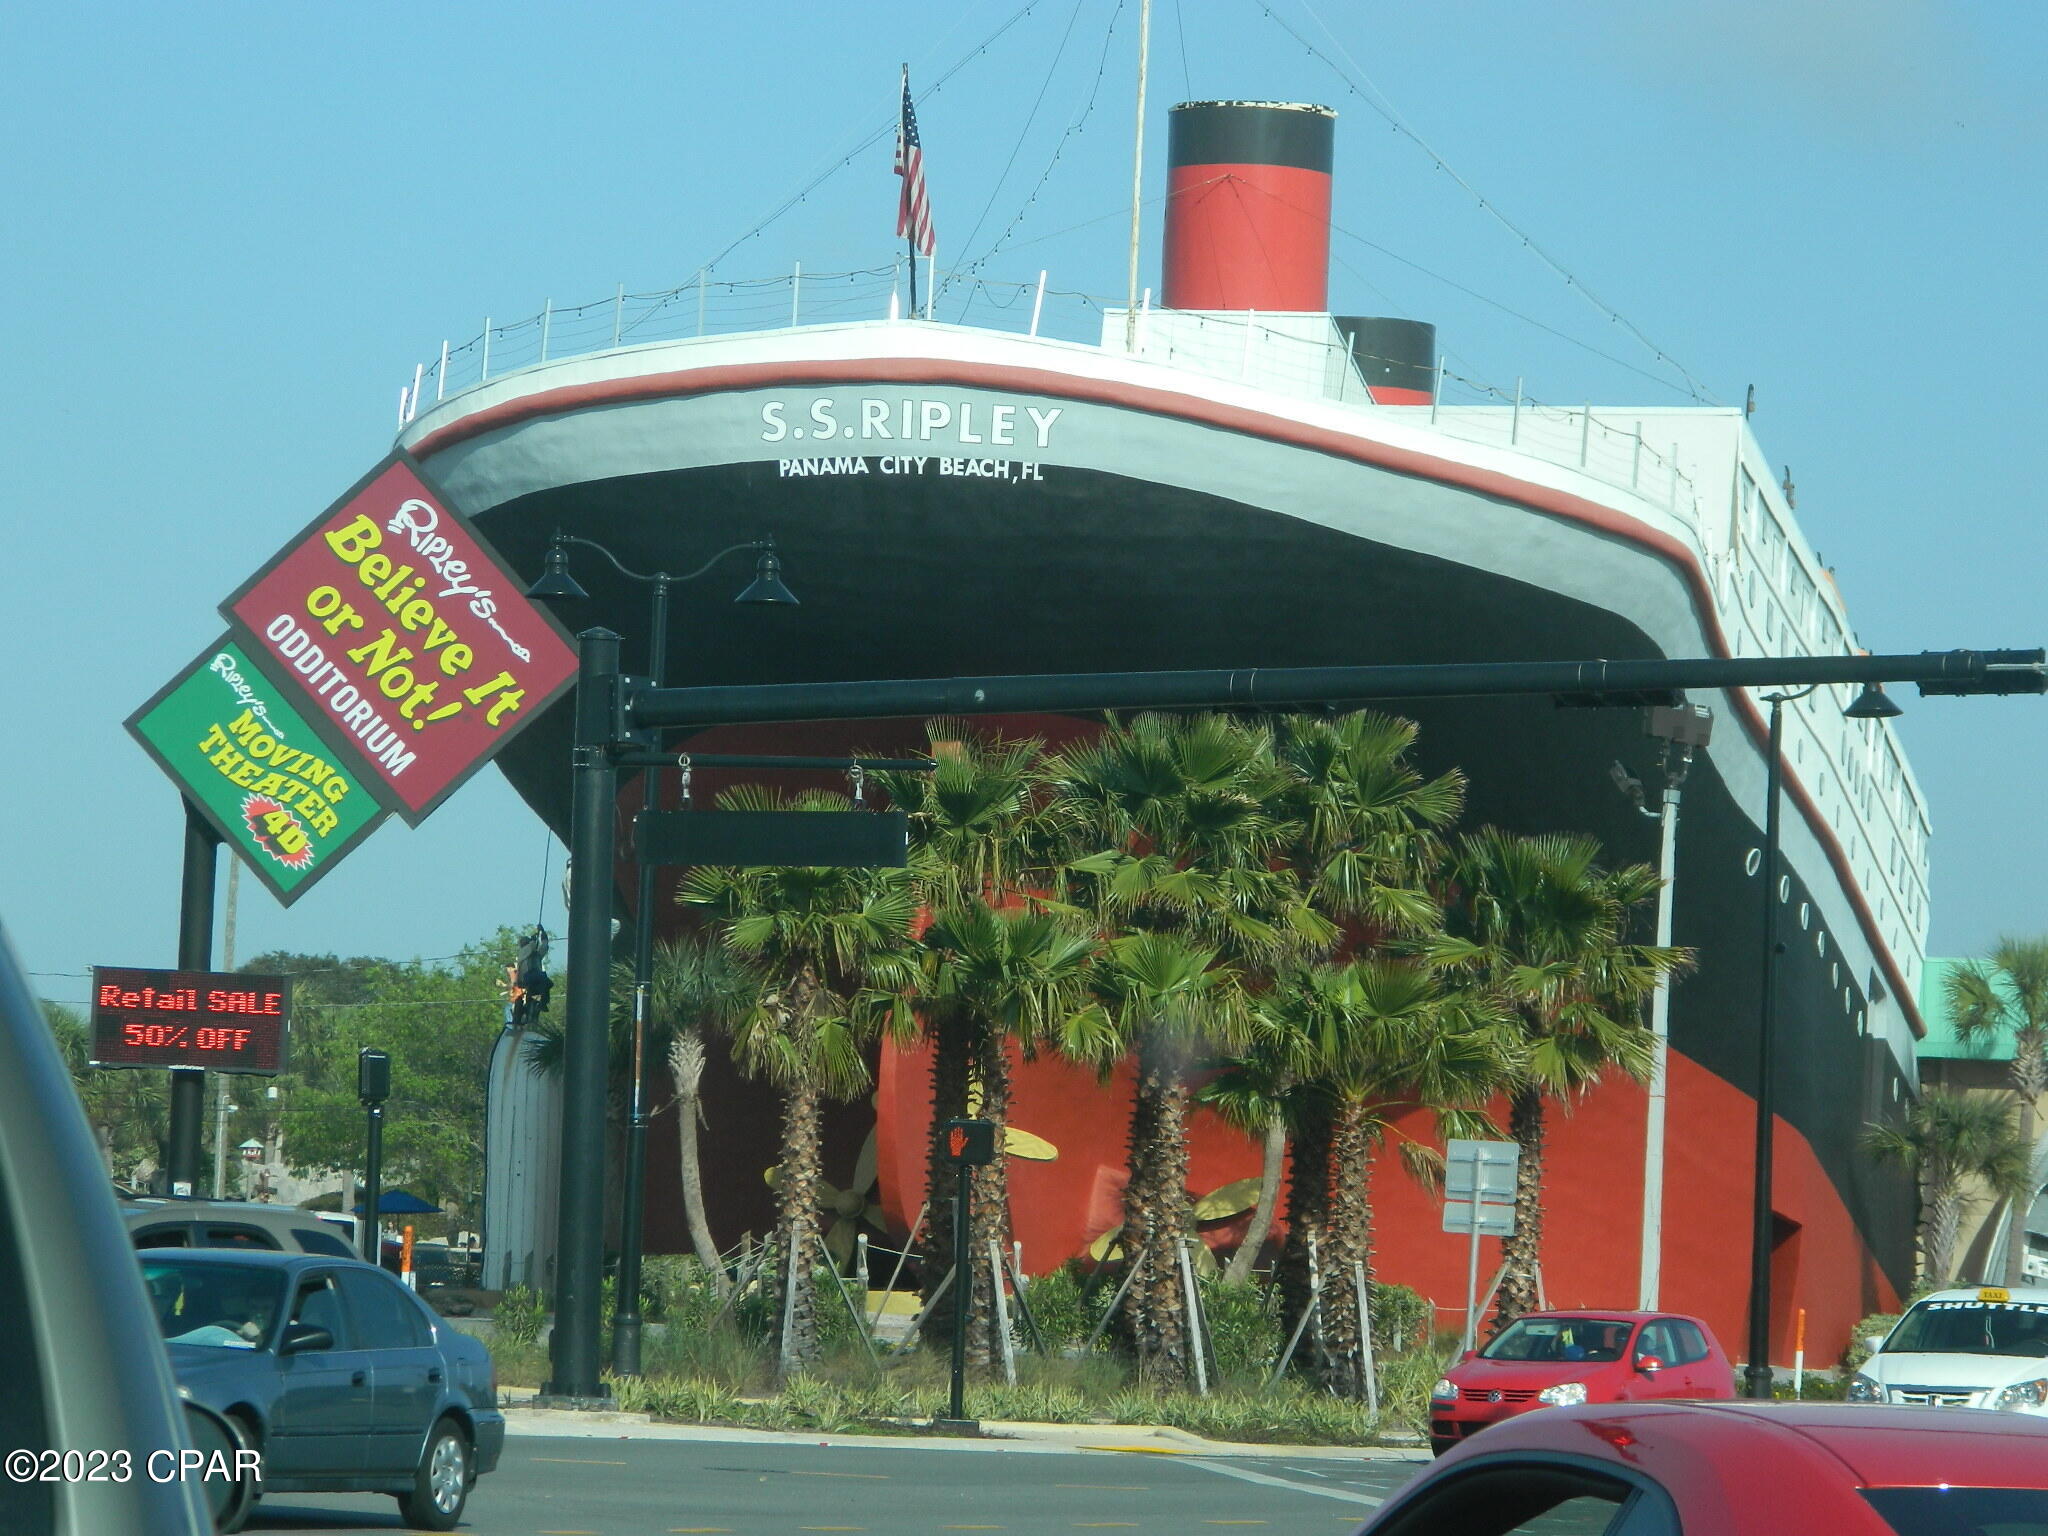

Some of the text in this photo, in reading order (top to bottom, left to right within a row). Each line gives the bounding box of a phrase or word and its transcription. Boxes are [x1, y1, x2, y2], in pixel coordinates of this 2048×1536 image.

[778, 457, 869, 478] PANAMA
[879, 455, 929, 476] CITY
[324, 513, 526, 727] Believe It
[306, 585, 463, 731] or Not!
[265, 613, 417, 778] ODDITORIUM
[227, 708, 349, 806] MOVING
[197, 723, 339, 839] THEATER
[262, 810, 307, 855] 4D
[100, 984, 282, 1015] Retail SALE
[123, 1024, 252, 1051] 50% OFF
[1927, 1301, 2048, 1315] SHUTTLE
[1983, 1291, 2004, 1299] TAXI
